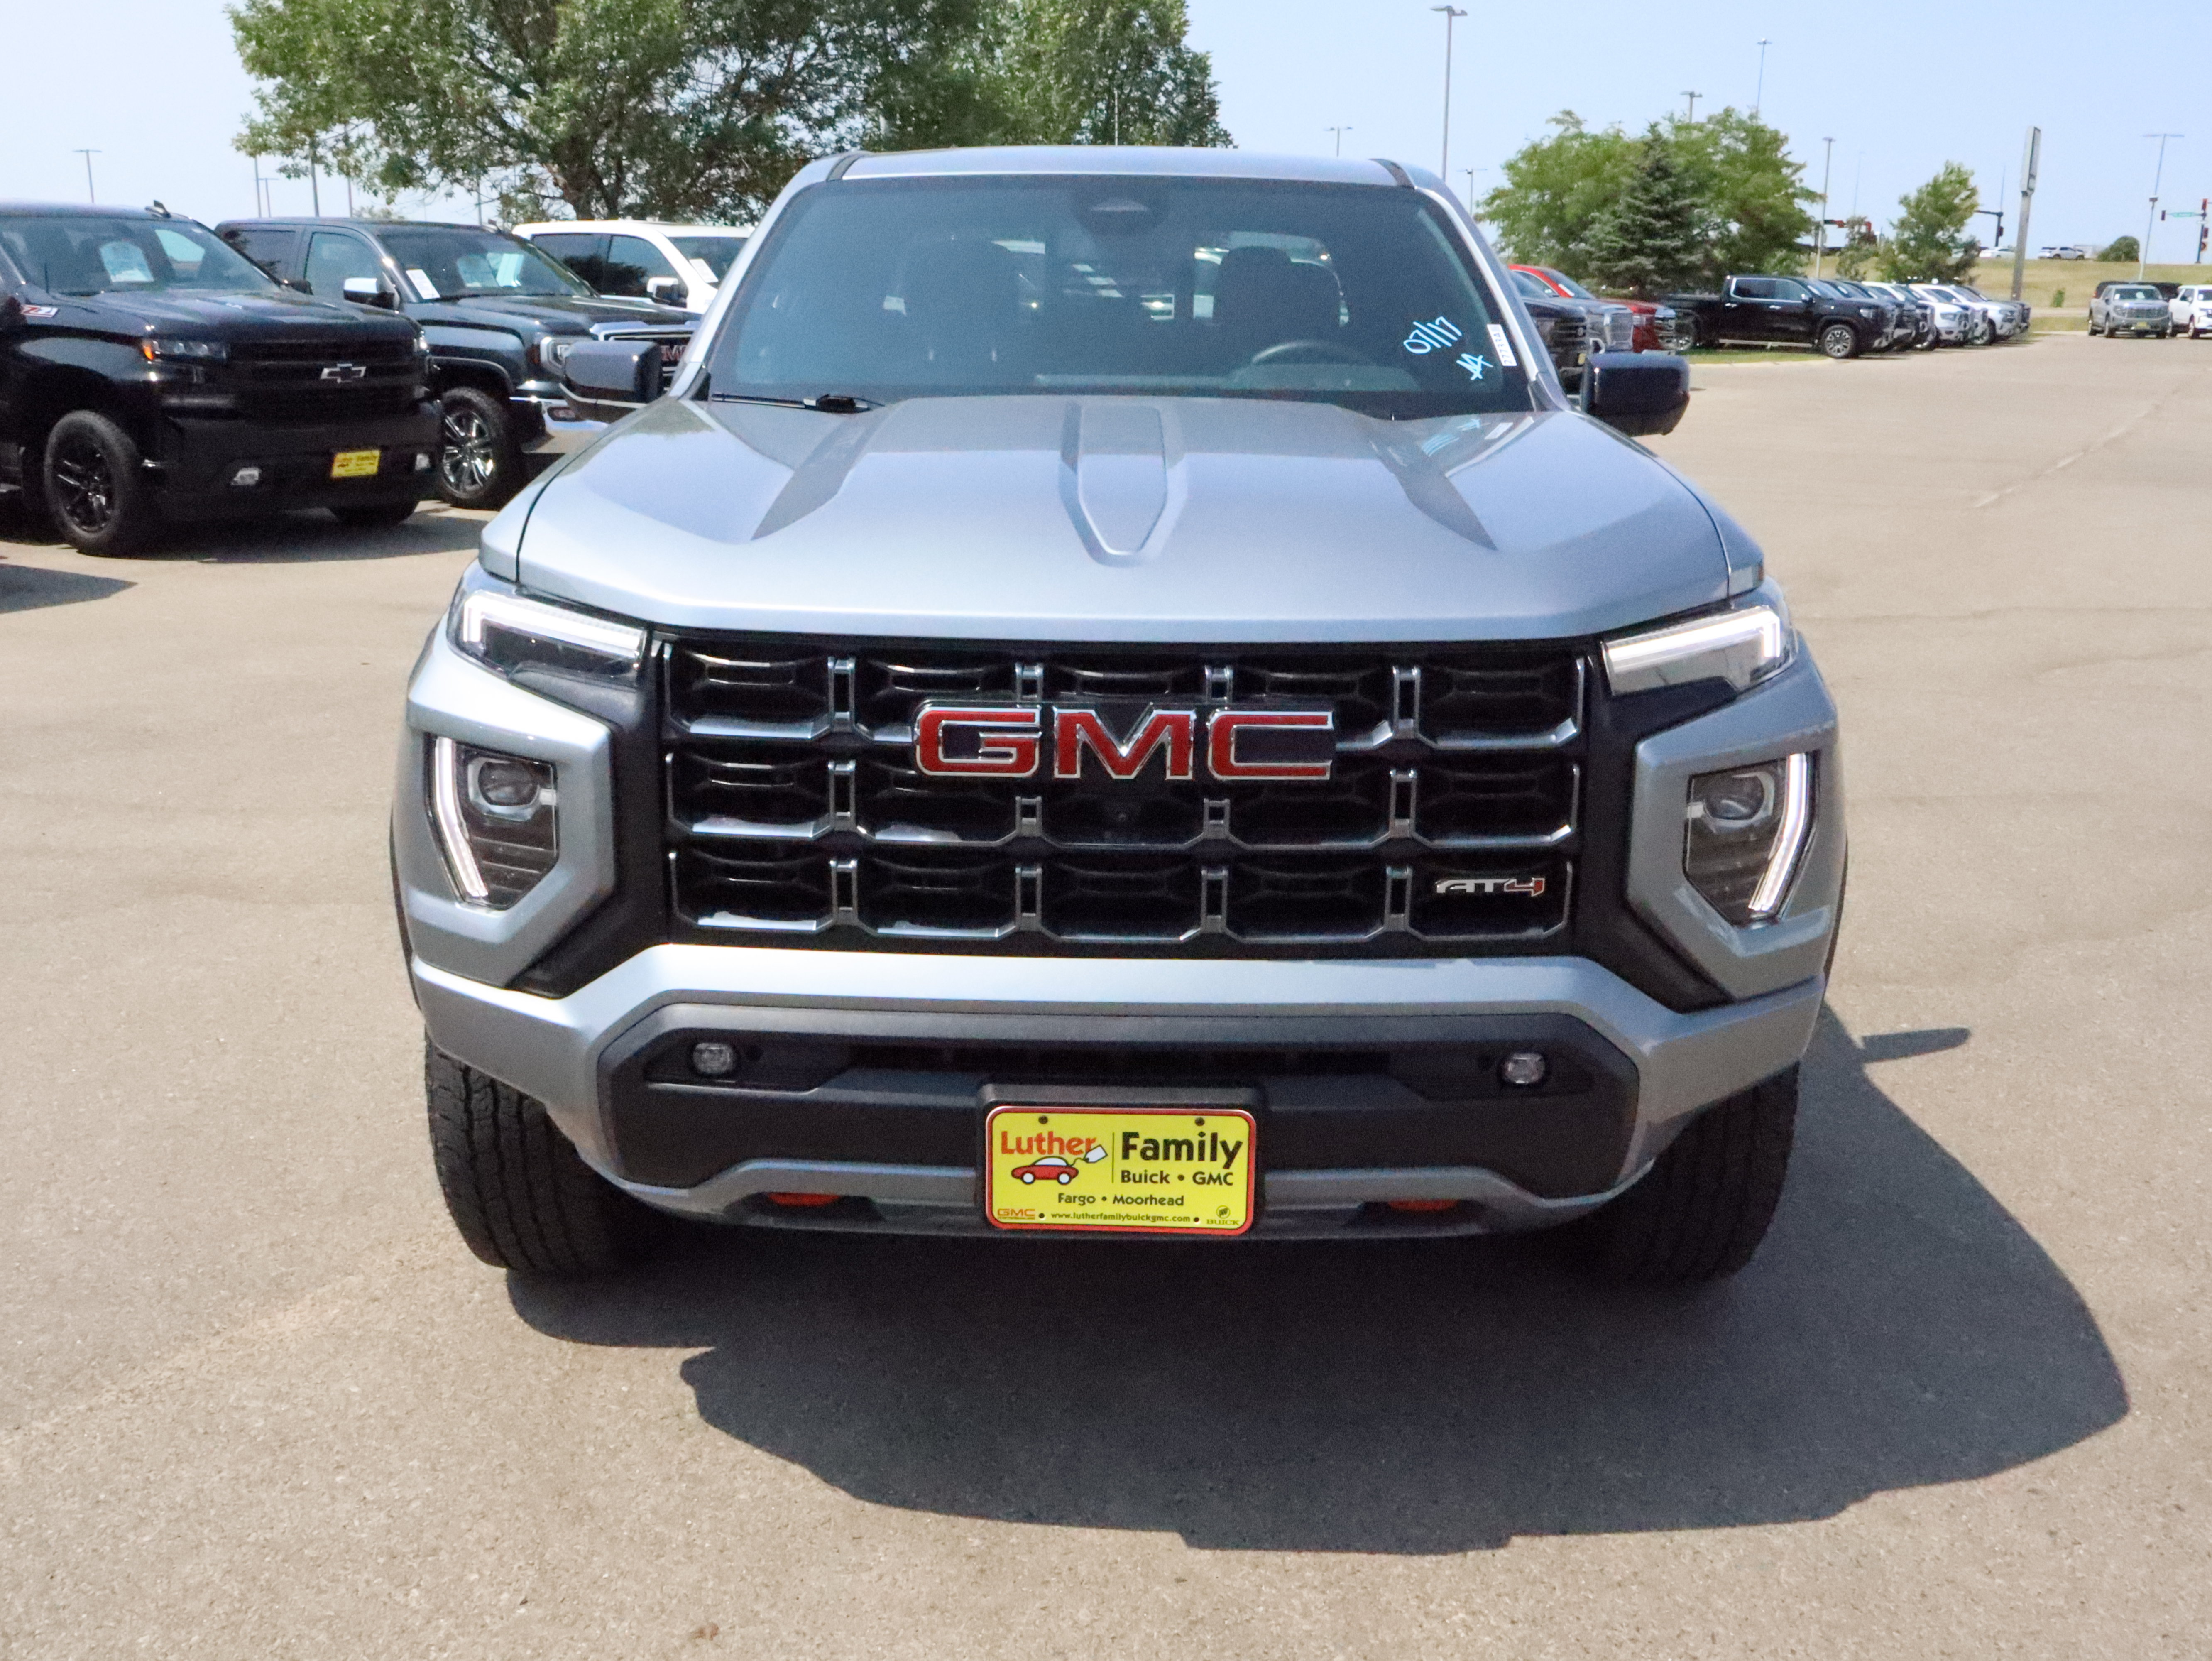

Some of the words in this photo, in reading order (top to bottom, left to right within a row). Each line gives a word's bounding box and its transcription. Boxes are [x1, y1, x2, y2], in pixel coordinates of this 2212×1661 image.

[915, 701, 1332, 780] GMC
[1435, 878, 1544, 897] AT4
[1001, 1131, 1096, 1155] Luther
[1121, 1131, 1243, 1169] Family
[1121, 1170, 1170, 1184] Buick
[1192, 1172, 1233, 1186] GMC
[1058, 1193, 1096, 1205] Fargo
[1113, 1194, 1184, 1206] Moorhead
[1051, 1212, 1190, 1222] www.lutherfamilybuickgmc.com
